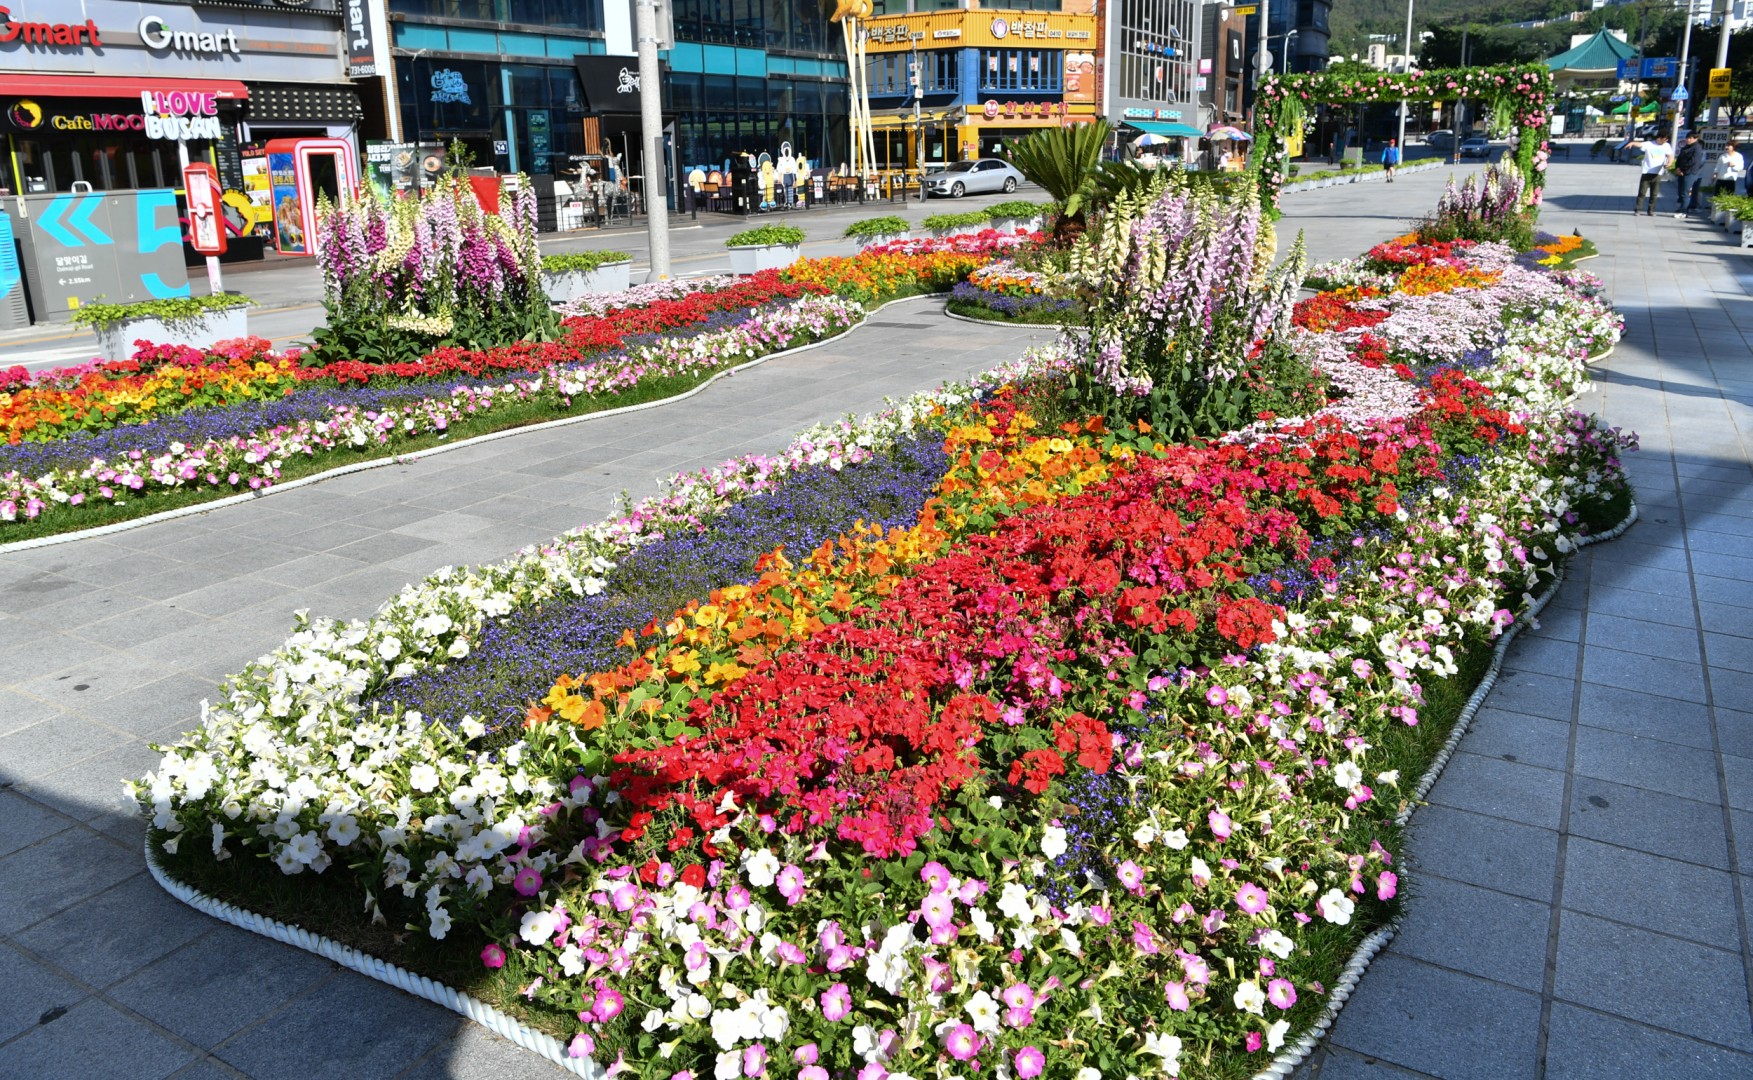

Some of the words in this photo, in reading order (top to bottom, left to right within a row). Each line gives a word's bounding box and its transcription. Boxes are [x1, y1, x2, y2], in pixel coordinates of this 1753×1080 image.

[139, 15, 240, 53] Gmart
[348, 0, 369, 51] art
[871, 24, 909, 42] 백철판
[1010, 20, 1048, 38] 백철판
[350, 65, 375, 75] 731-6006
[154, 91, 218, 115] LOVE
[52, 115, 92, 130] Cafe
[91, 113, 145, 131] MOO
[144, 115, 221, 140] BUSAN
[55, 254, 88, 266] 달맞이길
